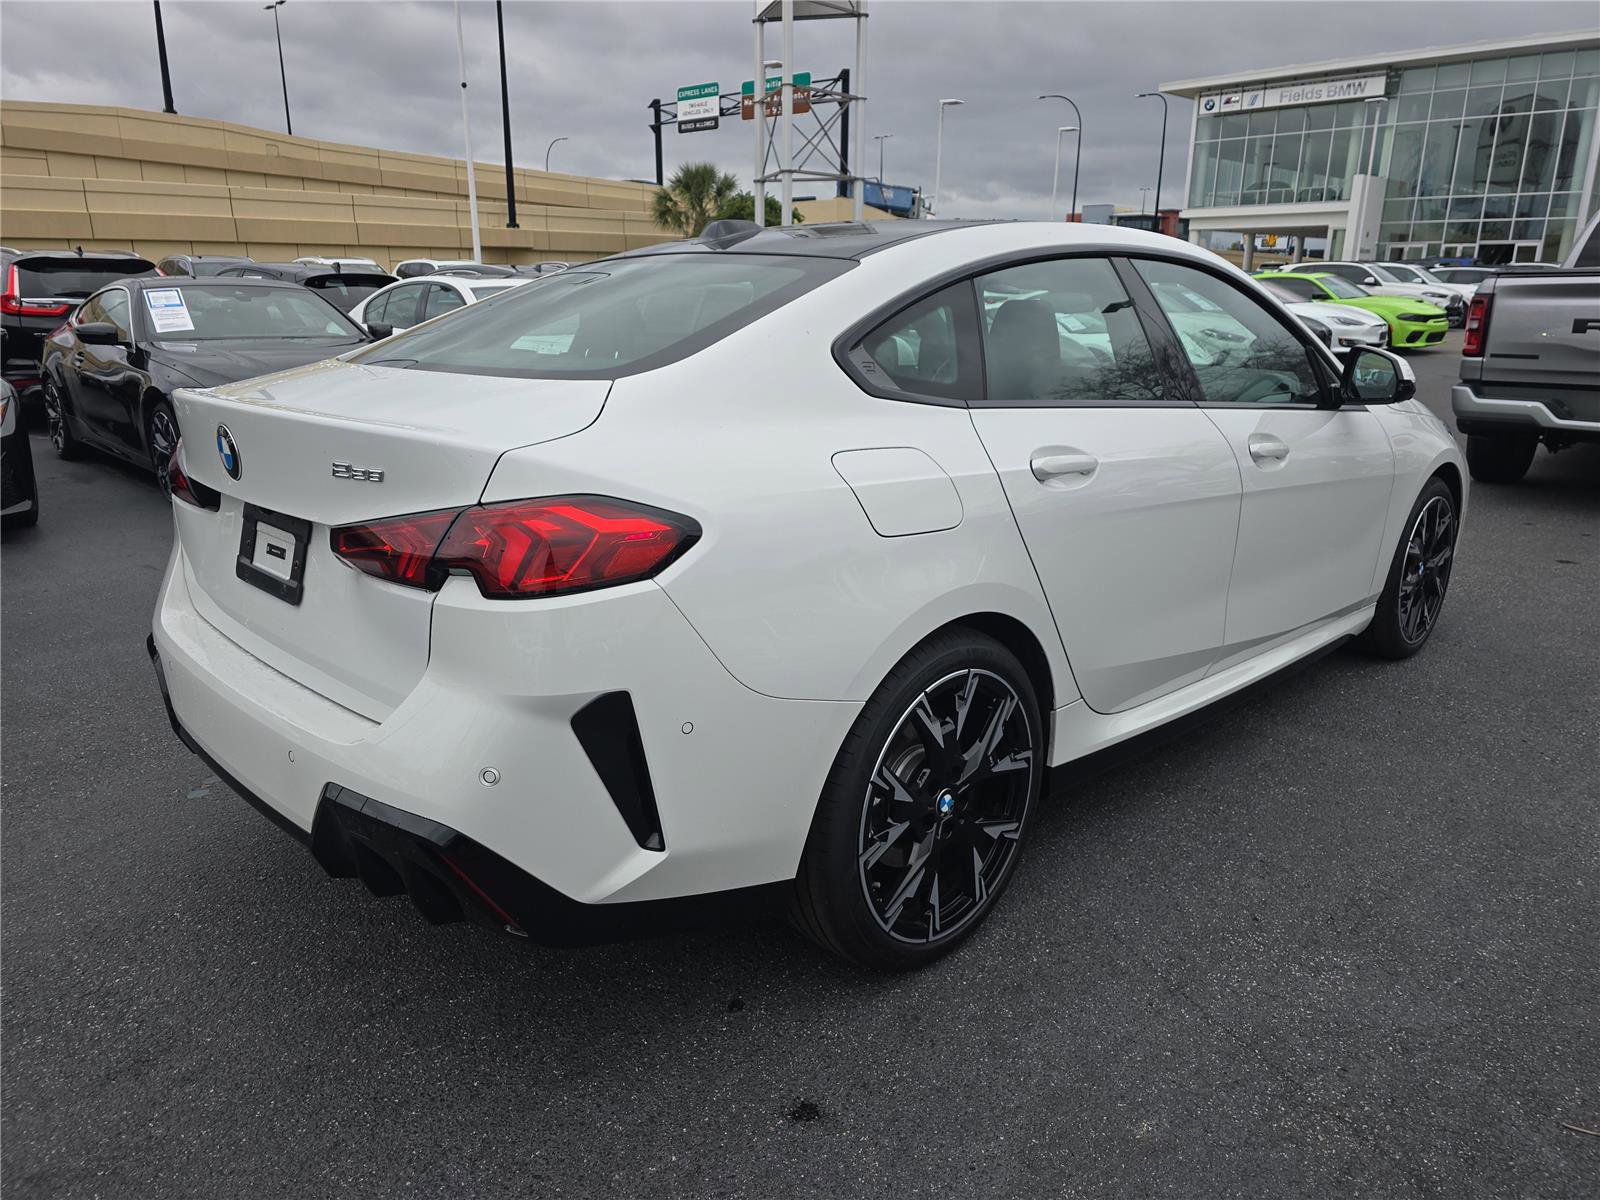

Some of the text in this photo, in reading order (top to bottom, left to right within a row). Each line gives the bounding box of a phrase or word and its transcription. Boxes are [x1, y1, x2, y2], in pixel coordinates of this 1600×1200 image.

[678, 85, 718, 98] EXPRESS LANES
[1280, 87, 1323, 103] Fields
[1326, 80, 1369, 98] BMW
[696, 119, 716, 128] ALLOWED
